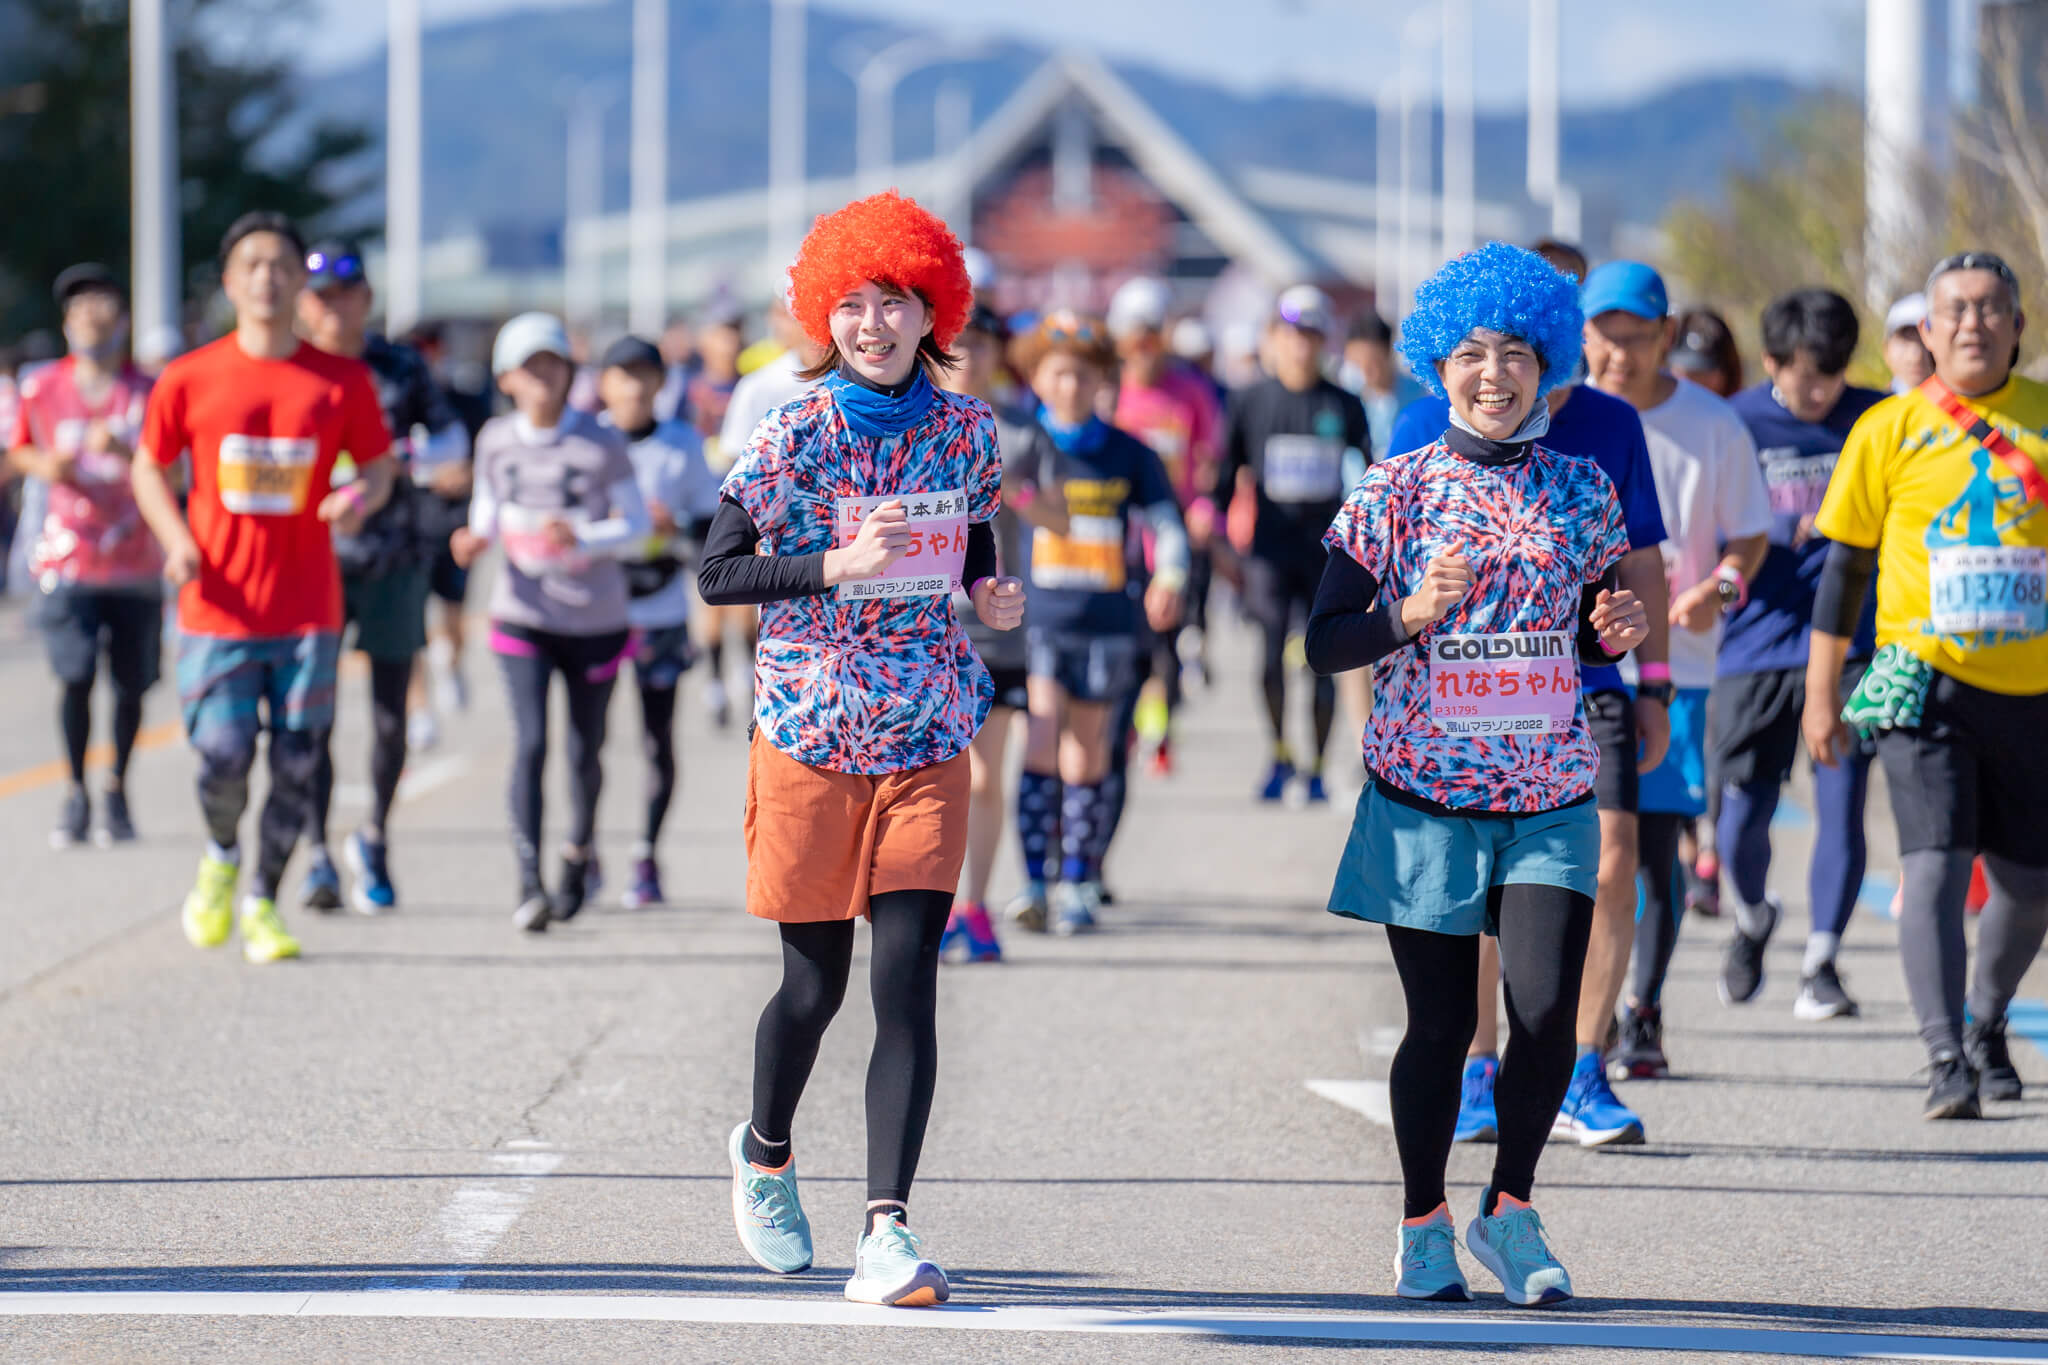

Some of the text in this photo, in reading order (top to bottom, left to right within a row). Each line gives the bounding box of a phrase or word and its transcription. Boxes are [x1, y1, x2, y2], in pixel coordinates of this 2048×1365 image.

[852, 580, 944, 596] 富山マラソン2022
[1436, 666, 1573, 699] れなちゃん
[1434, 705, 1478, 716] P31795
[1446, 719, 1543, 733] 富山マラソン2022
